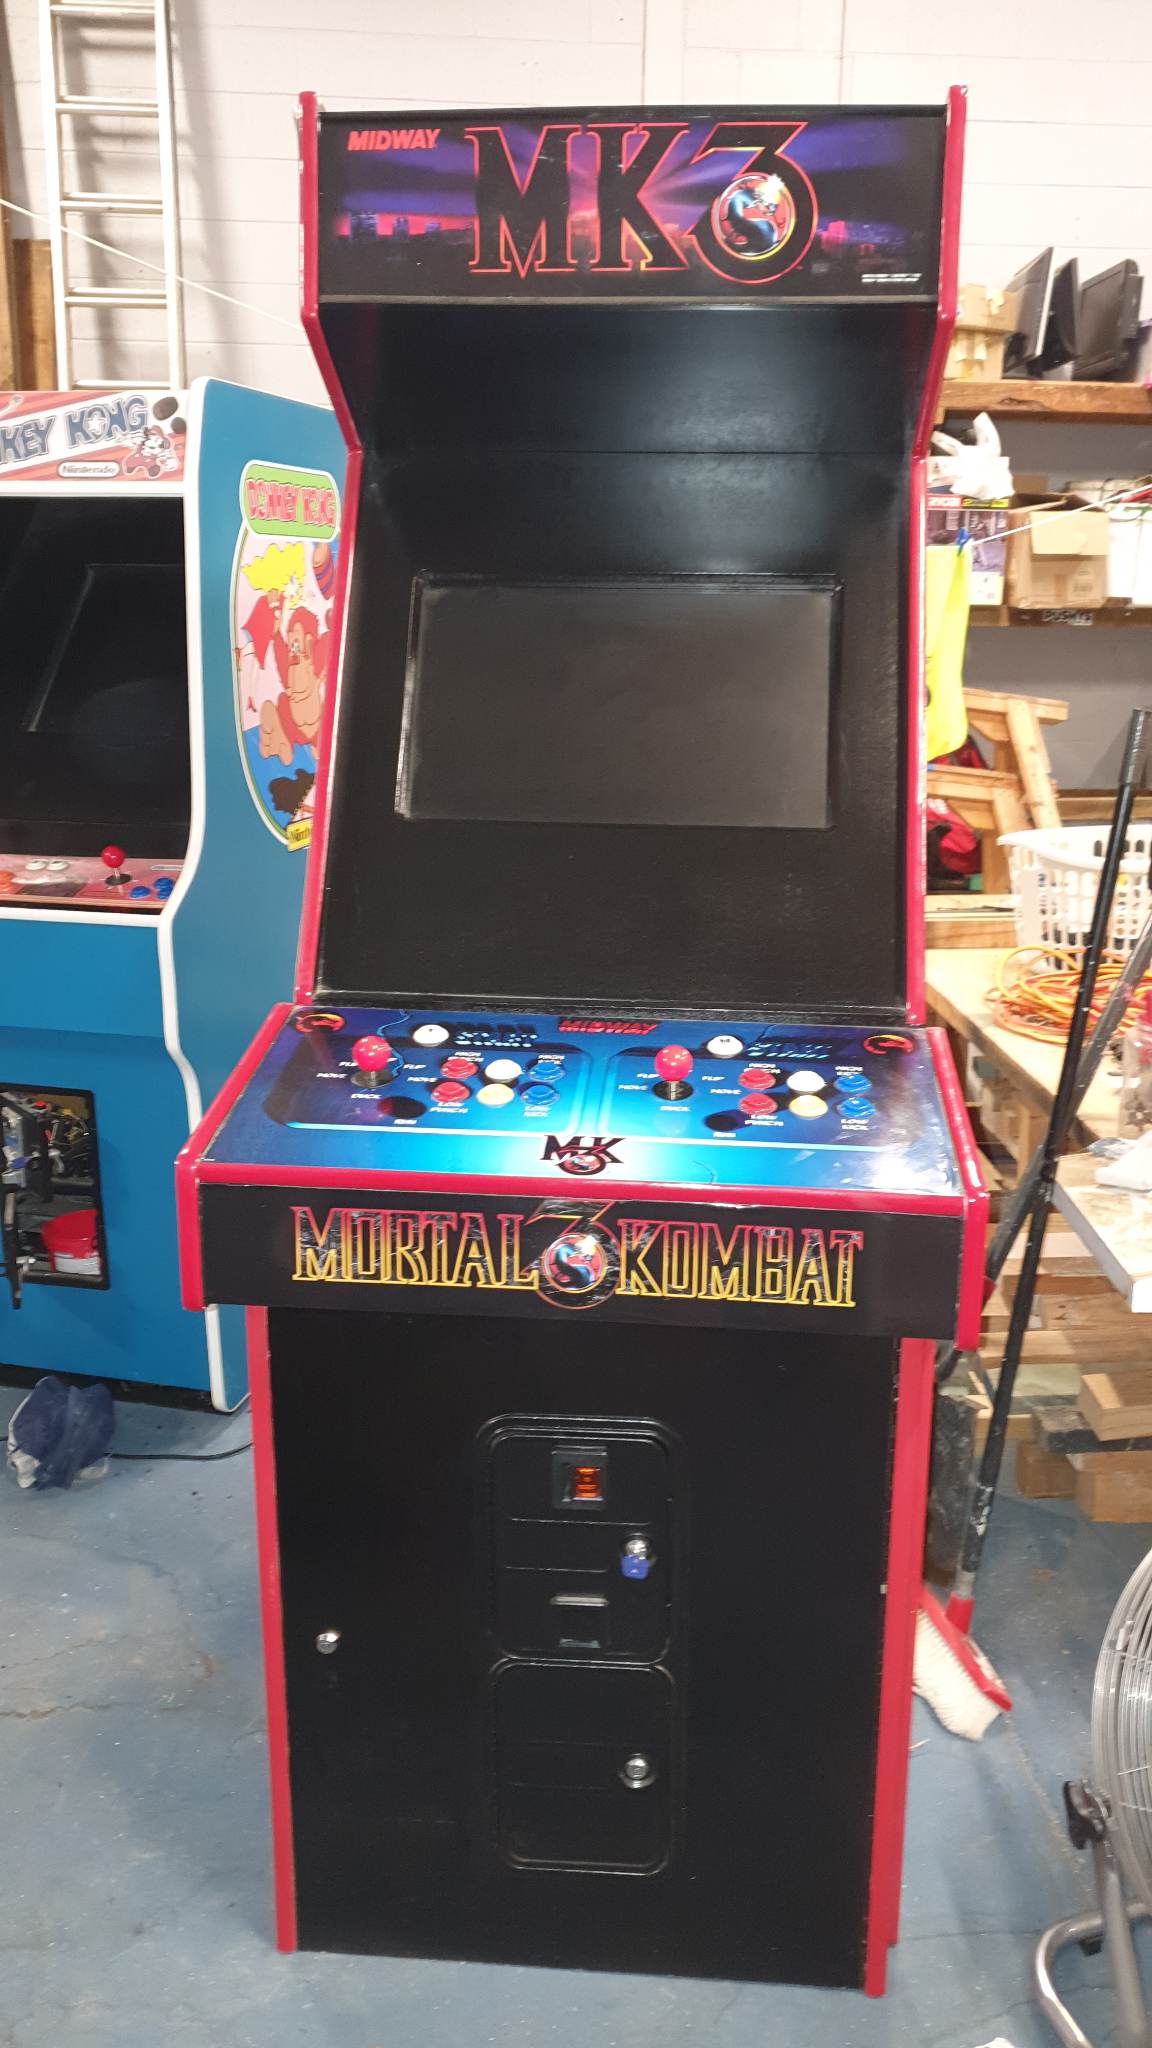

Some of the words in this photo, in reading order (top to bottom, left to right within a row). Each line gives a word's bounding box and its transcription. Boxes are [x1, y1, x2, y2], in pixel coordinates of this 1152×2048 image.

[347, 128, 441, 151] MIDWAY
[65, 395, 149, 449] KONG
[62, 465, 116, 475] Nintendo
[301, 486, 336, 527] KONG
[559, 1020, 657, 1035] MIDWAY
[289, 1206, 540, 1291] MORTAL
[616, 1218, 865, 1308] KOMBAT
